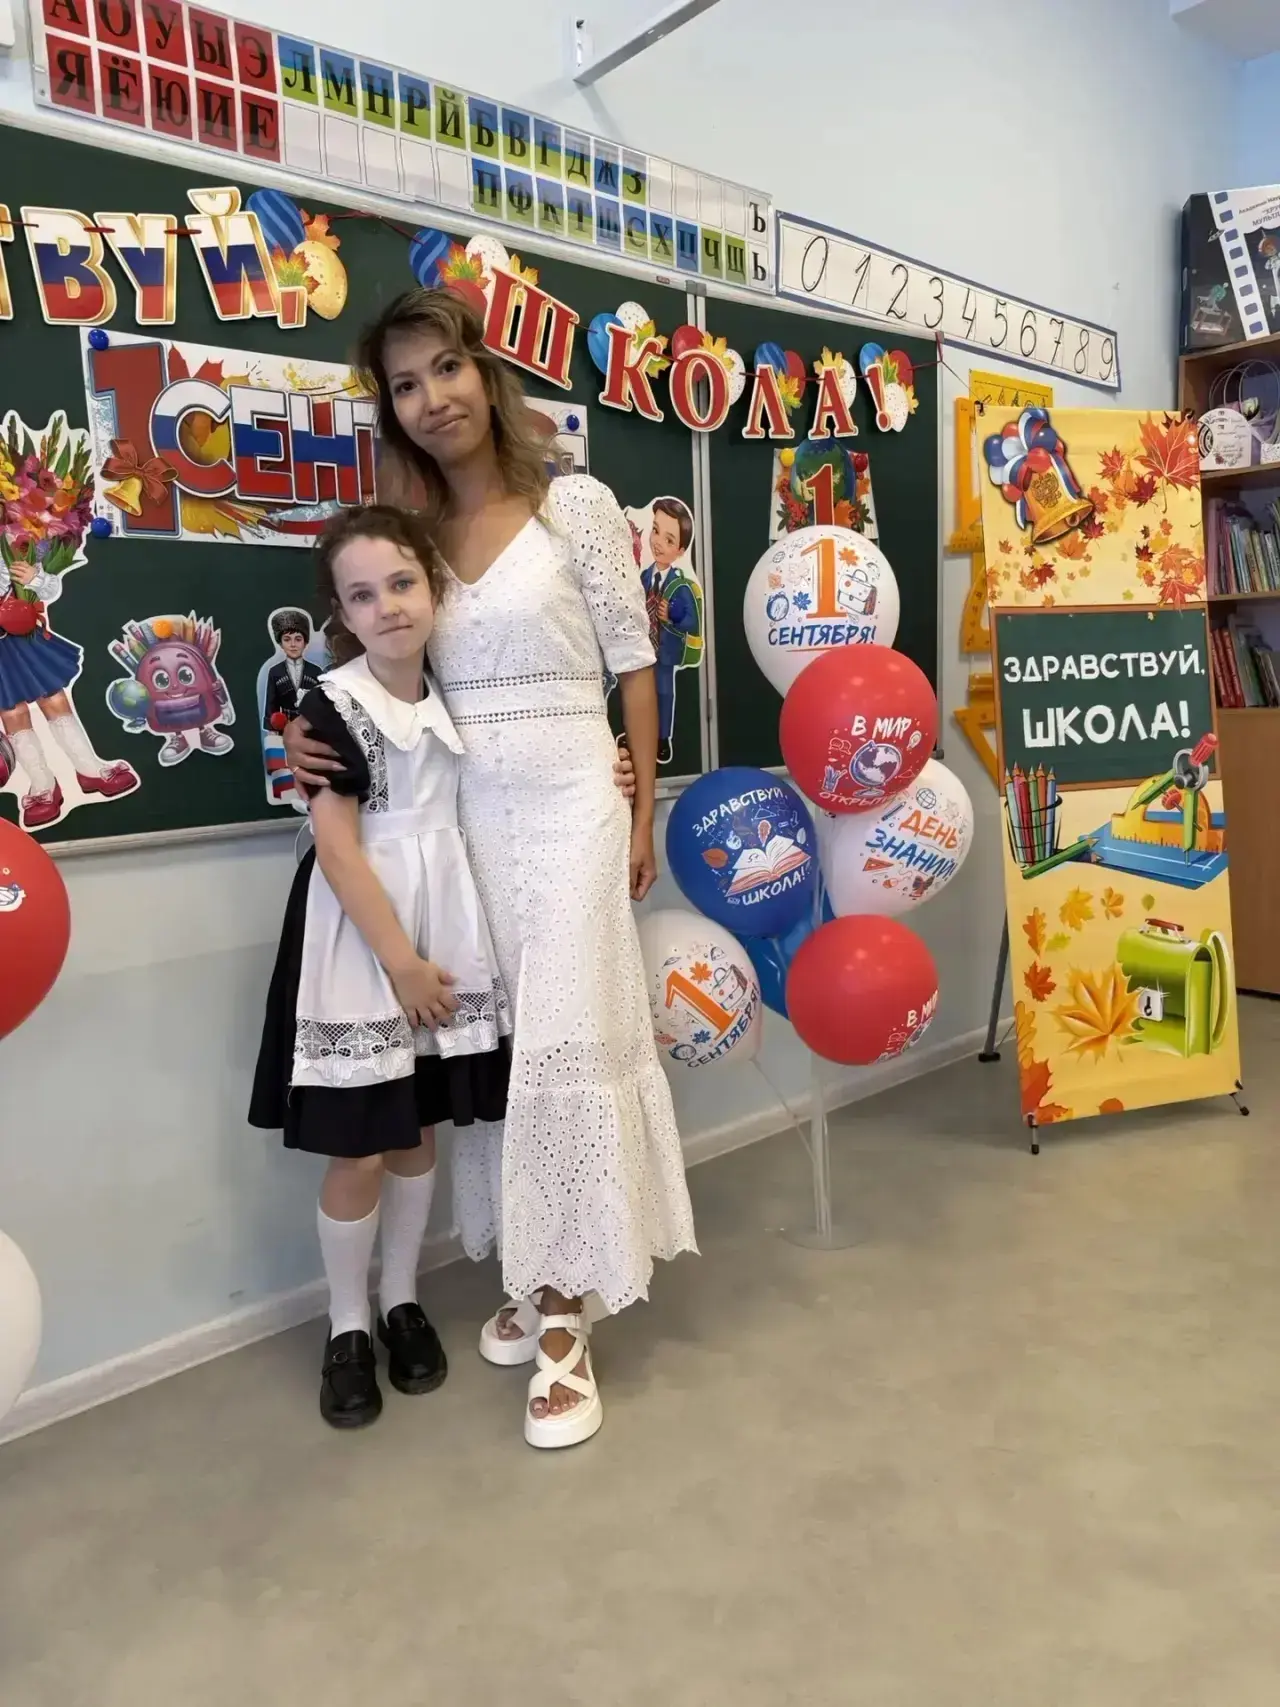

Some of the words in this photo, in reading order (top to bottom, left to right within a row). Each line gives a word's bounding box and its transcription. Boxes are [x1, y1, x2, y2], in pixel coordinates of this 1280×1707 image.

[100, 0, 131, 37] О
[148, 5, 176, 49] У
[194, 20, 229, 69] Ы
[240, 36, 268, 79] Э
[284, 50, 315, 94] Л
[324, 59, 357, 107] М
[362, 74, 392, 118] Н
[403, 84, 427, 126] Р
[438, 89, 463, 139] Й
[474, 108, 494, 148] Б
[508, 119, 527, 157] В
[567, 142, 588, 185] Д
[750, 201, 766, 233] Ъ
[56, 48, 89, 101] Я
[103, 56, 143, 117] Ё
[152, 75, 189, 126] Ю
[200, 88, 237, 140] И
[247, 102, 277, 149] Е
[476, 169, 501, 208] П
[508, 182, 532, 216] Ф
[627, 216, 645, 247] С
[653, 220, 672, 257] Х
[704, 237, 720, 270] Ч
[752, 251, 766, 282] Ь
[800, 235, 829, 292] 0
[851, 252, 872, 305] 1
[886, 263, 908, 319] 2
[924, 276, 944, 328] 3
[961, 287, 977, 339] 4
[990, 298, 1008, 348] 5
[1020, 309, 1036, 356] 6
[1049, 317, 1064, 366] 7
[1073, 328, 1089, 374] 8
[1099, 337, 1113, 380] 9
[481, 264, 894, 441] ШКОЛА!
[88, 342, 182, 538] 1
[149, 379, 379, 506] СЕН
[805, 463, 835, 526] 1
[800, 538, 848, 618] 1
[768, 623, 877, 646] СЕНТЯБРЯ!
[1004, 644, 1205, 683] ЗДРАВСТВУЙ,
[851, 715, 867, 736] В
[871, 717, 912, 740] МИР
[1022, 701, 1190, 748] ШКОЛА!
[865, 828, 958, 881] ЗНАНИЙ!
[898, 809, 958, 849] ДЕНЬ
[742, 866, 806, 906] ШКОЛА!
[665, 969, 739, 1041] 1
[906, 1009, 918, 1028] В
